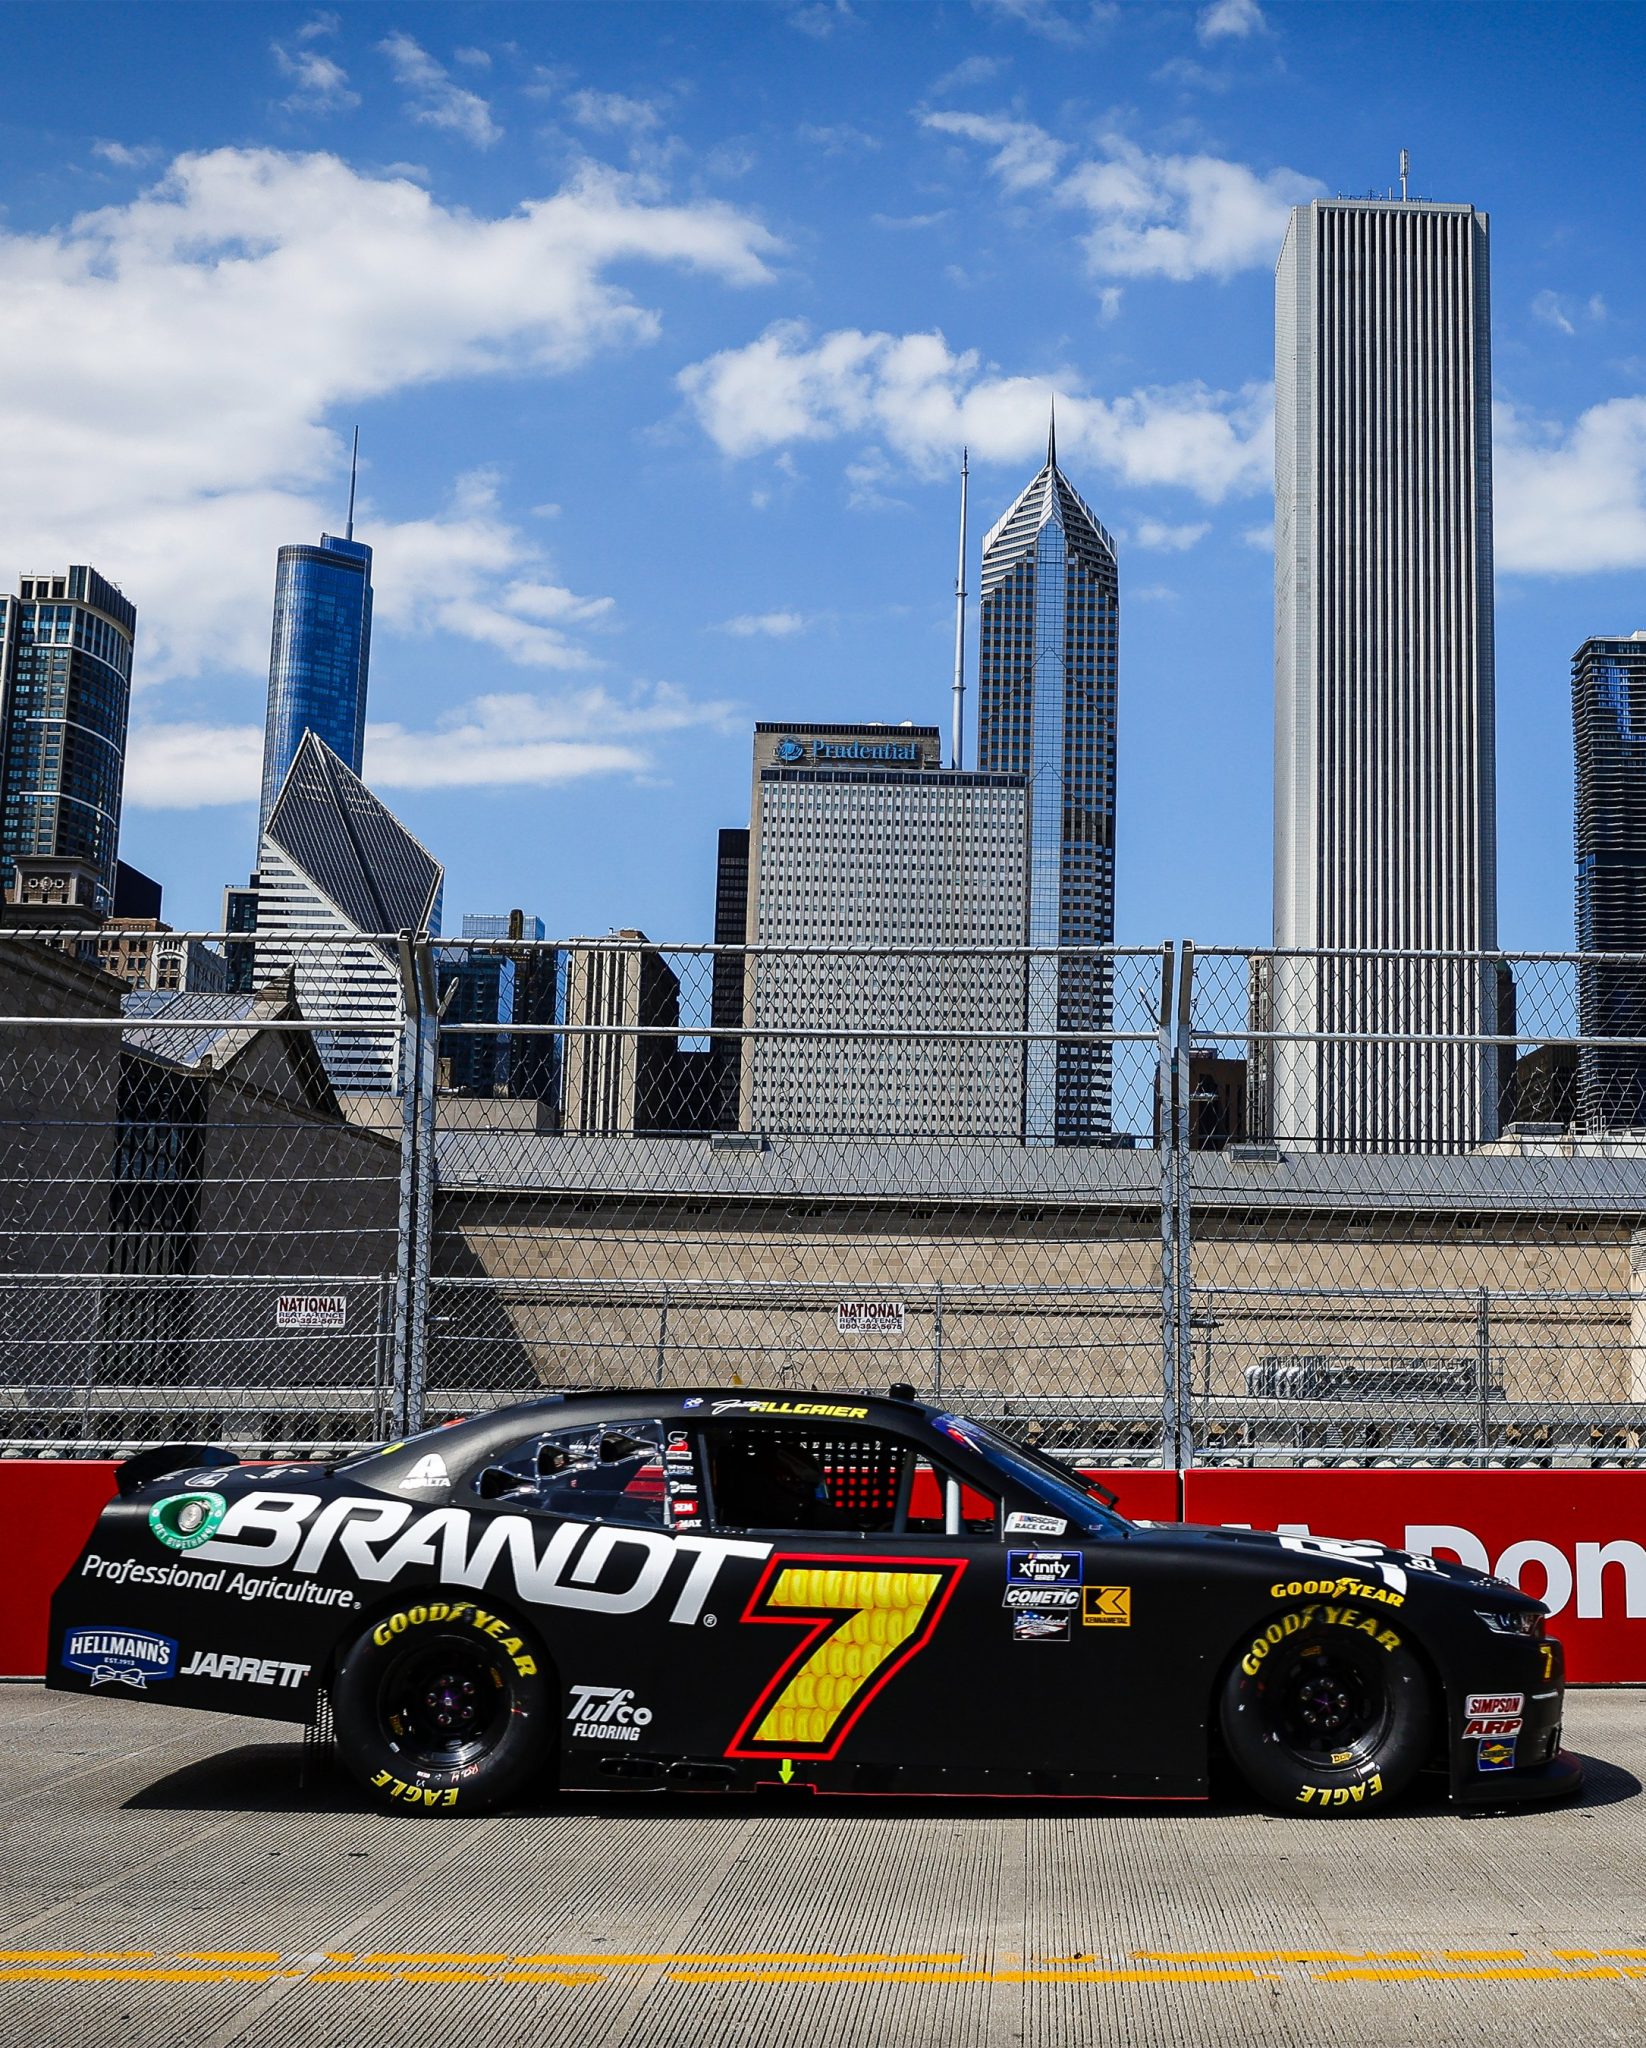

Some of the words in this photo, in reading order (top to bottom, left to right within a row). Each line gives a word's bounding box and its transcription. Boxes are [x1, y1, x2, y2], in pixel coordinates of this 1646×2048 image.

[813, 739, 916, 760] Prudential
[280, 1297, 344, 1312] NATIONAL
[840, 1303, 903, 1317] NATIONAL
[749, 1401, 869, 1419] ALLGAIER
[1014, 1522, 1037, 1530] RACE
[1039, 1524, 1057, 1532] CAR
[180, 1491, 774, 1626] BRANDT
[1019, 1559, 1071, 1578] xfinity
[81, 1554, 227, 1591] Professional
[225, 1572, 354, 1608] Agriculture
[1270, 1578, 1405, 1608] GOODYEAR
[1006, 1589, 1080, 1605] COMETIC
[69, 1636, 171, 1665] HELLMANN'S
[373, 1602, 538, 1678] GOODYEAR
[1241, 1604, 1402, 1676] GOODYEAR
[179, 1651, 311, 1688] JARRETT
[724, 1553, 969, 1760] 7
[566, 1685, 652, 1726] Tufco
[1469, 1697, 1520, 1714] SIMPSON
[572, 1722, 641, 1741] FLOORING
[1465, 1719, 1521, 1735] ARP
[370, 1769, 459, 1806] EAGLE
[1296, 1773, 1383, 1806] EAGLE
